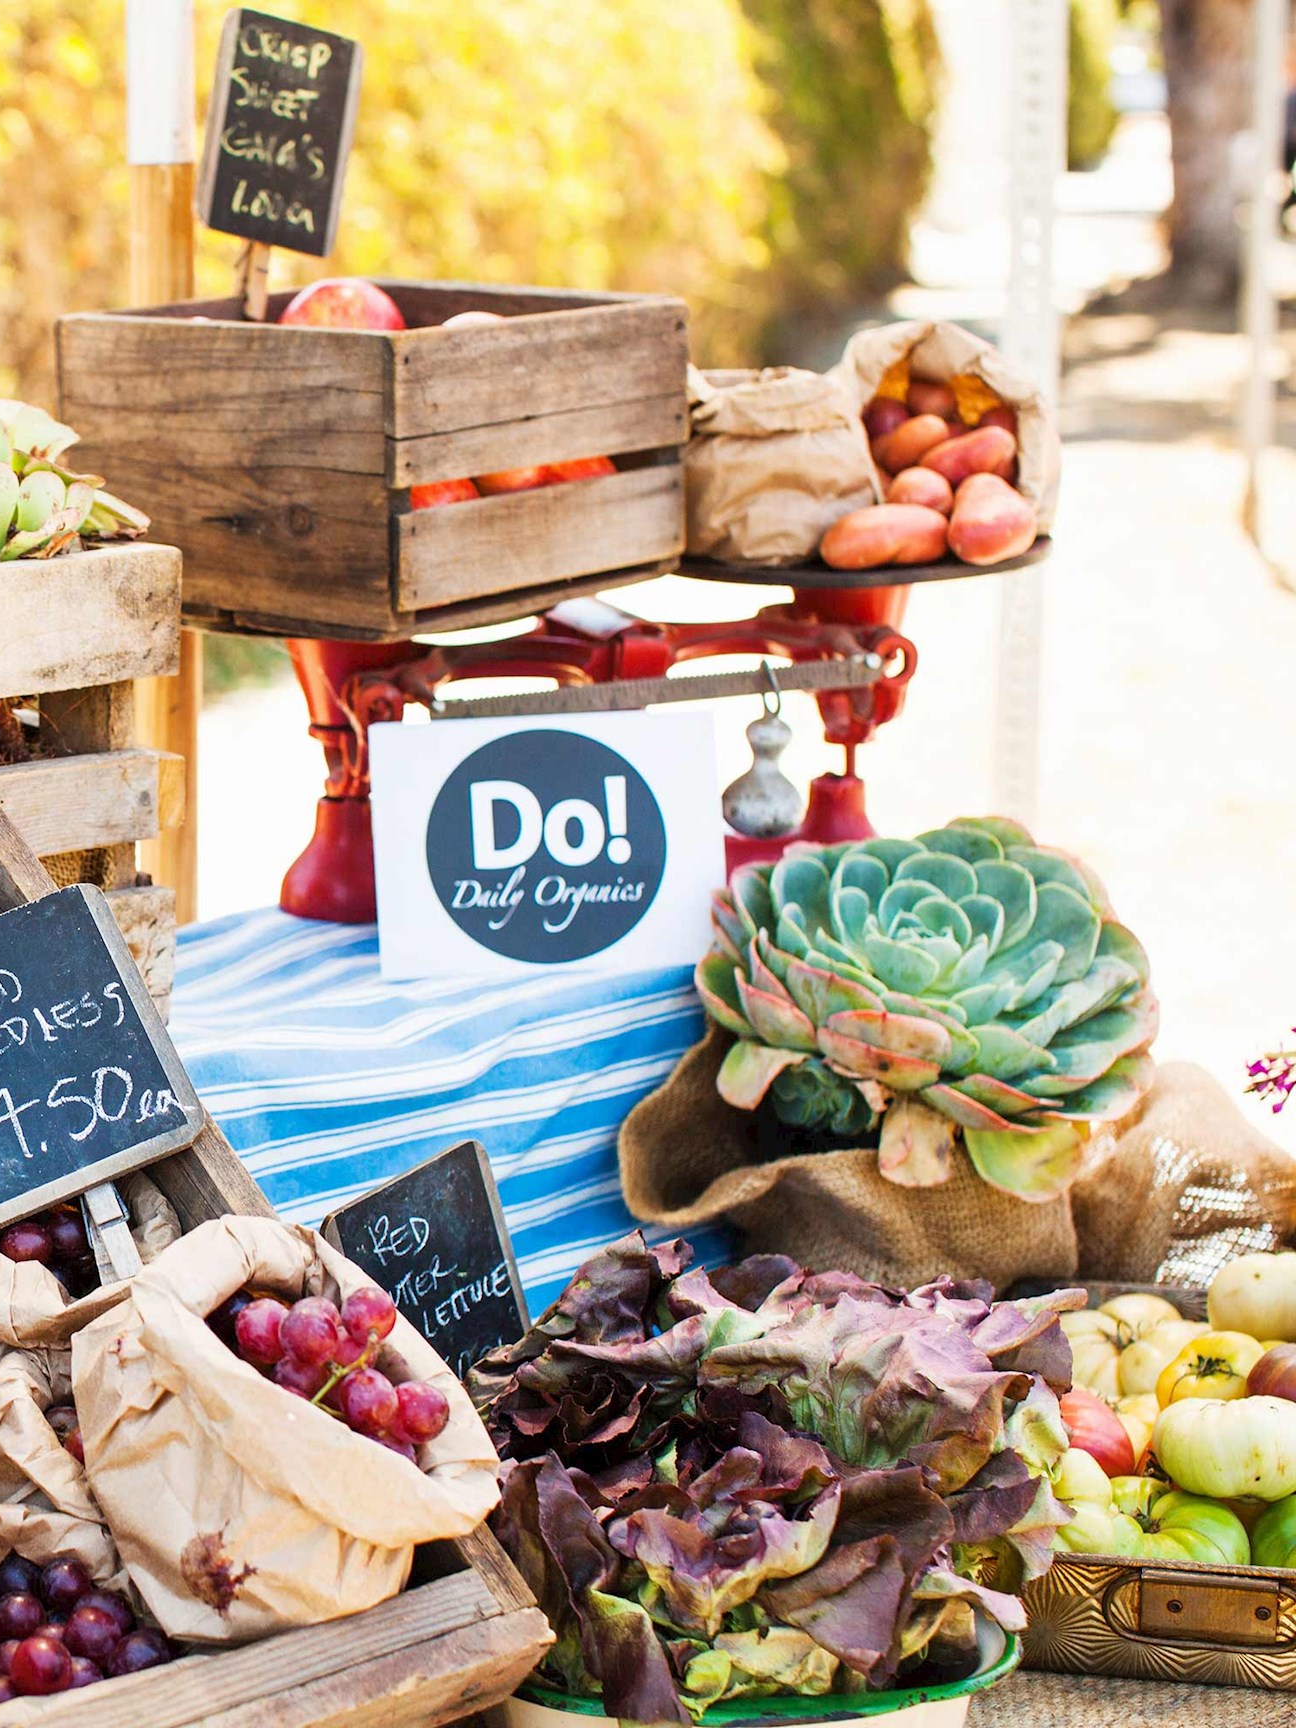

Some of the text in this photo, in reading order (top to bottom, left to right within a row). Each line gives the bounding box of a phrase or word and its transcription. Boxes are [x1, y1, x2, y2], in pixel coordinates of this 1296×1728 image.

[469, 775, 633, 870] Do!
[451, 865, 646, 933] Daily Organics
[367, 1213, 431, 1267] RED
[389, 1253, 459, 1308] UTTER
[422, 1258, 512, 1339] LETTUCE
